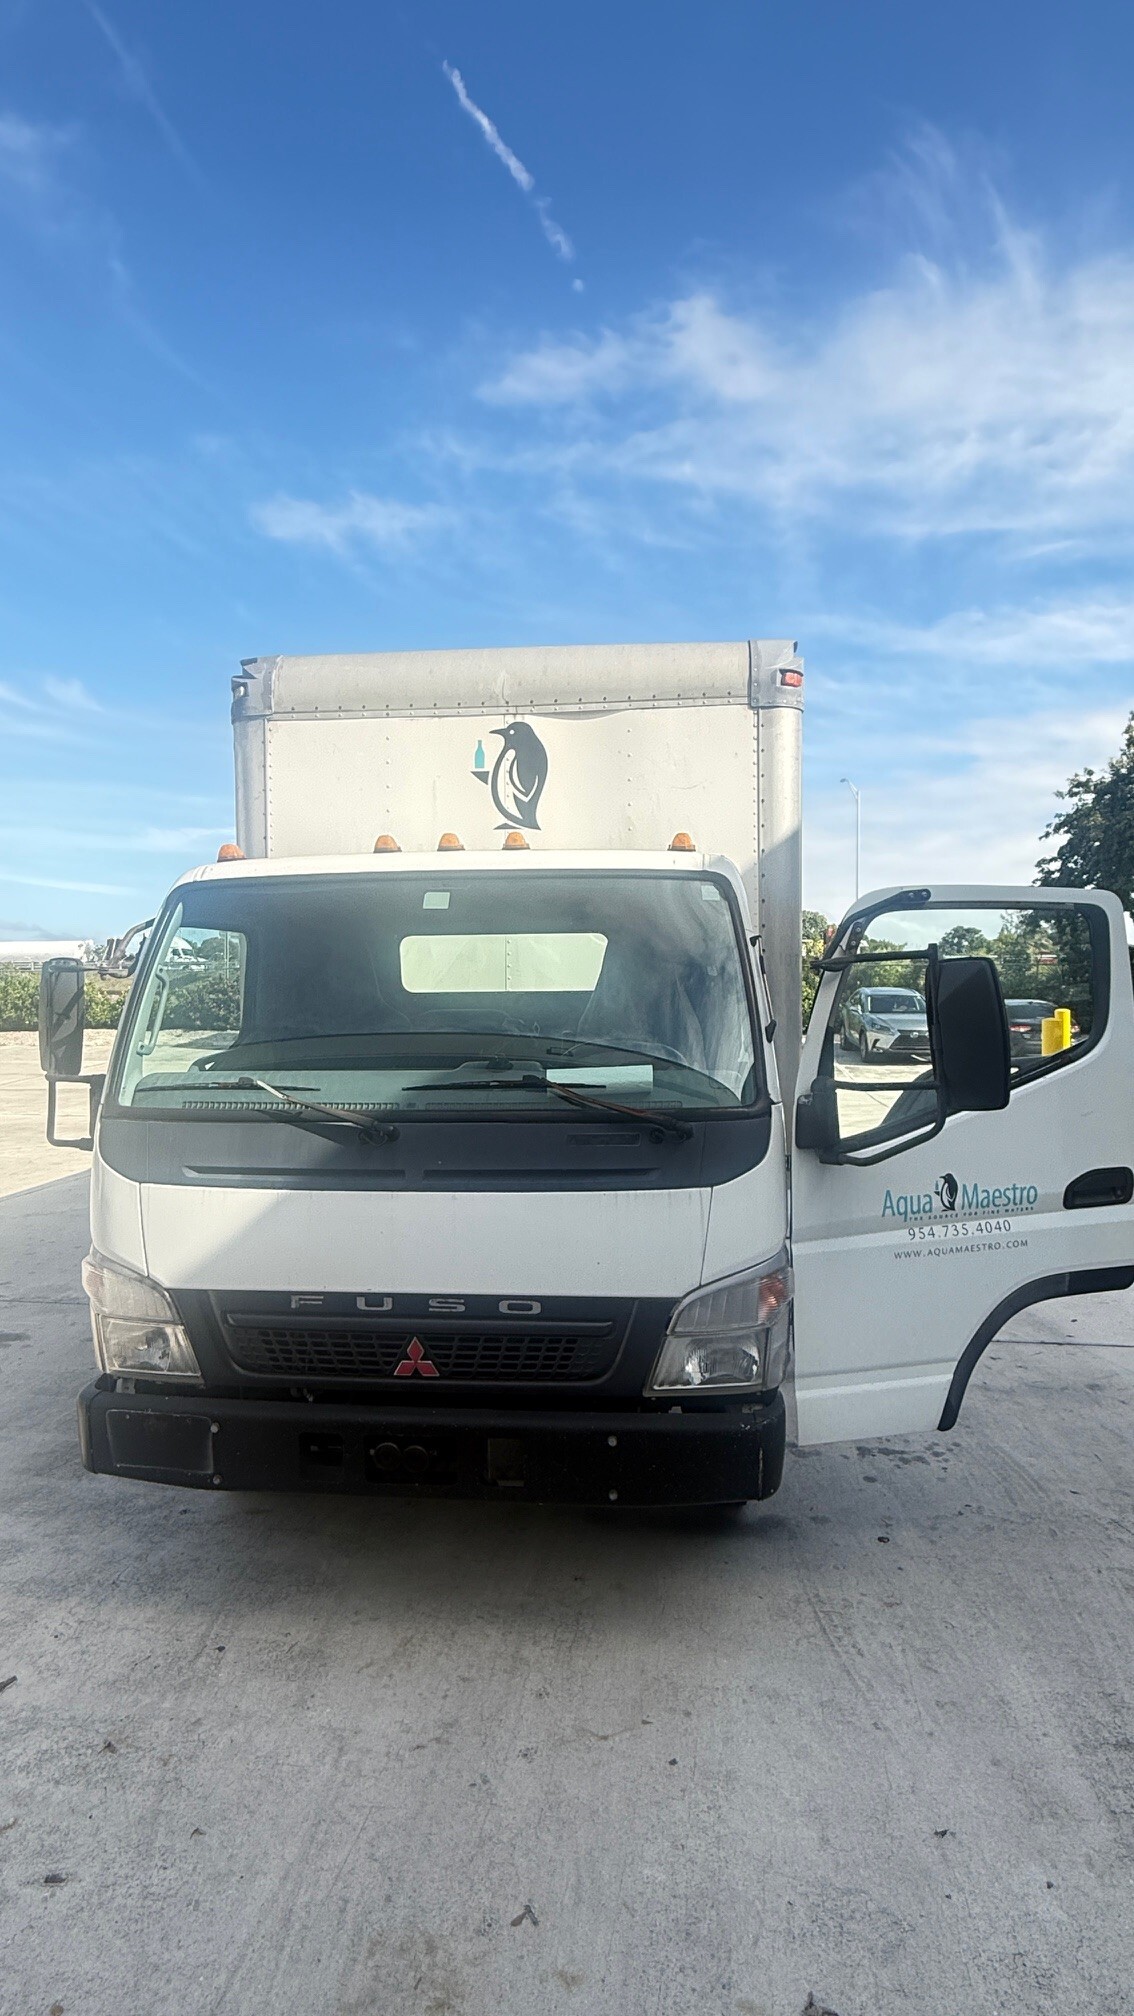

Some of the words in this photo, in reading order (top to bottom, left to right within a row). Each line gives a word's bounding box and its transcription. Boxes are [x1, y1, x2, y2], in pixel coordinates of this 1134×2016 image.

[881, 1189, 933, 1222] Aqua
[961, 1183, 1038, 1211] Maestro
[908, 1219, 1011, 1241] 954.735.4040
[894, 1239, 1028, 1260] WWW.AQUAMAESTRO.COM
[290, 1295, 542, 1315] FUSO
